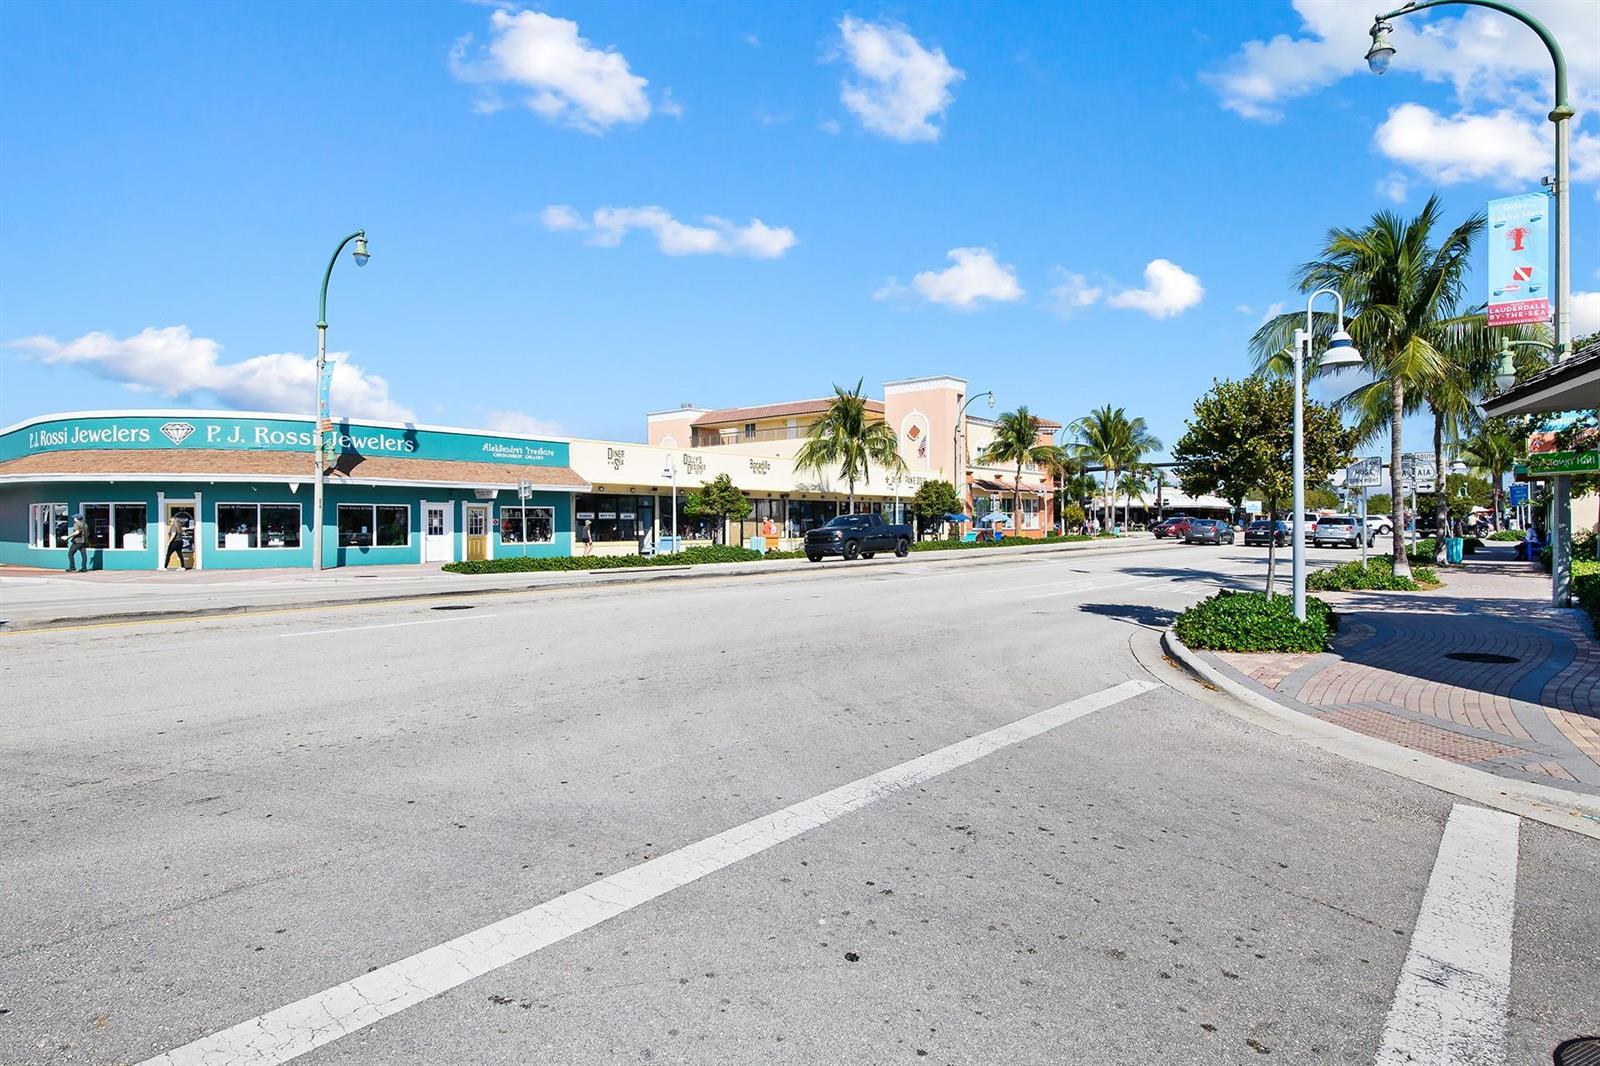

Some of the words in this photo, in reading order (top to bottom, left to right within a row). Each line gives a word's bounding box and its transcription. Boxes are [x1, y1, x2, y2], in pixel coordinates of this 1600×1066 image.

[1489, 303, 1546, 314] LAUDERDALE
[40, 427, 68, 446] Rossi
[71, 425, 150, 443] Jewelers
[254, 427, 318, 446] Rossi
[329, 431, 414, 452] Jewelers
[607, 447, 625, 460] DINER
